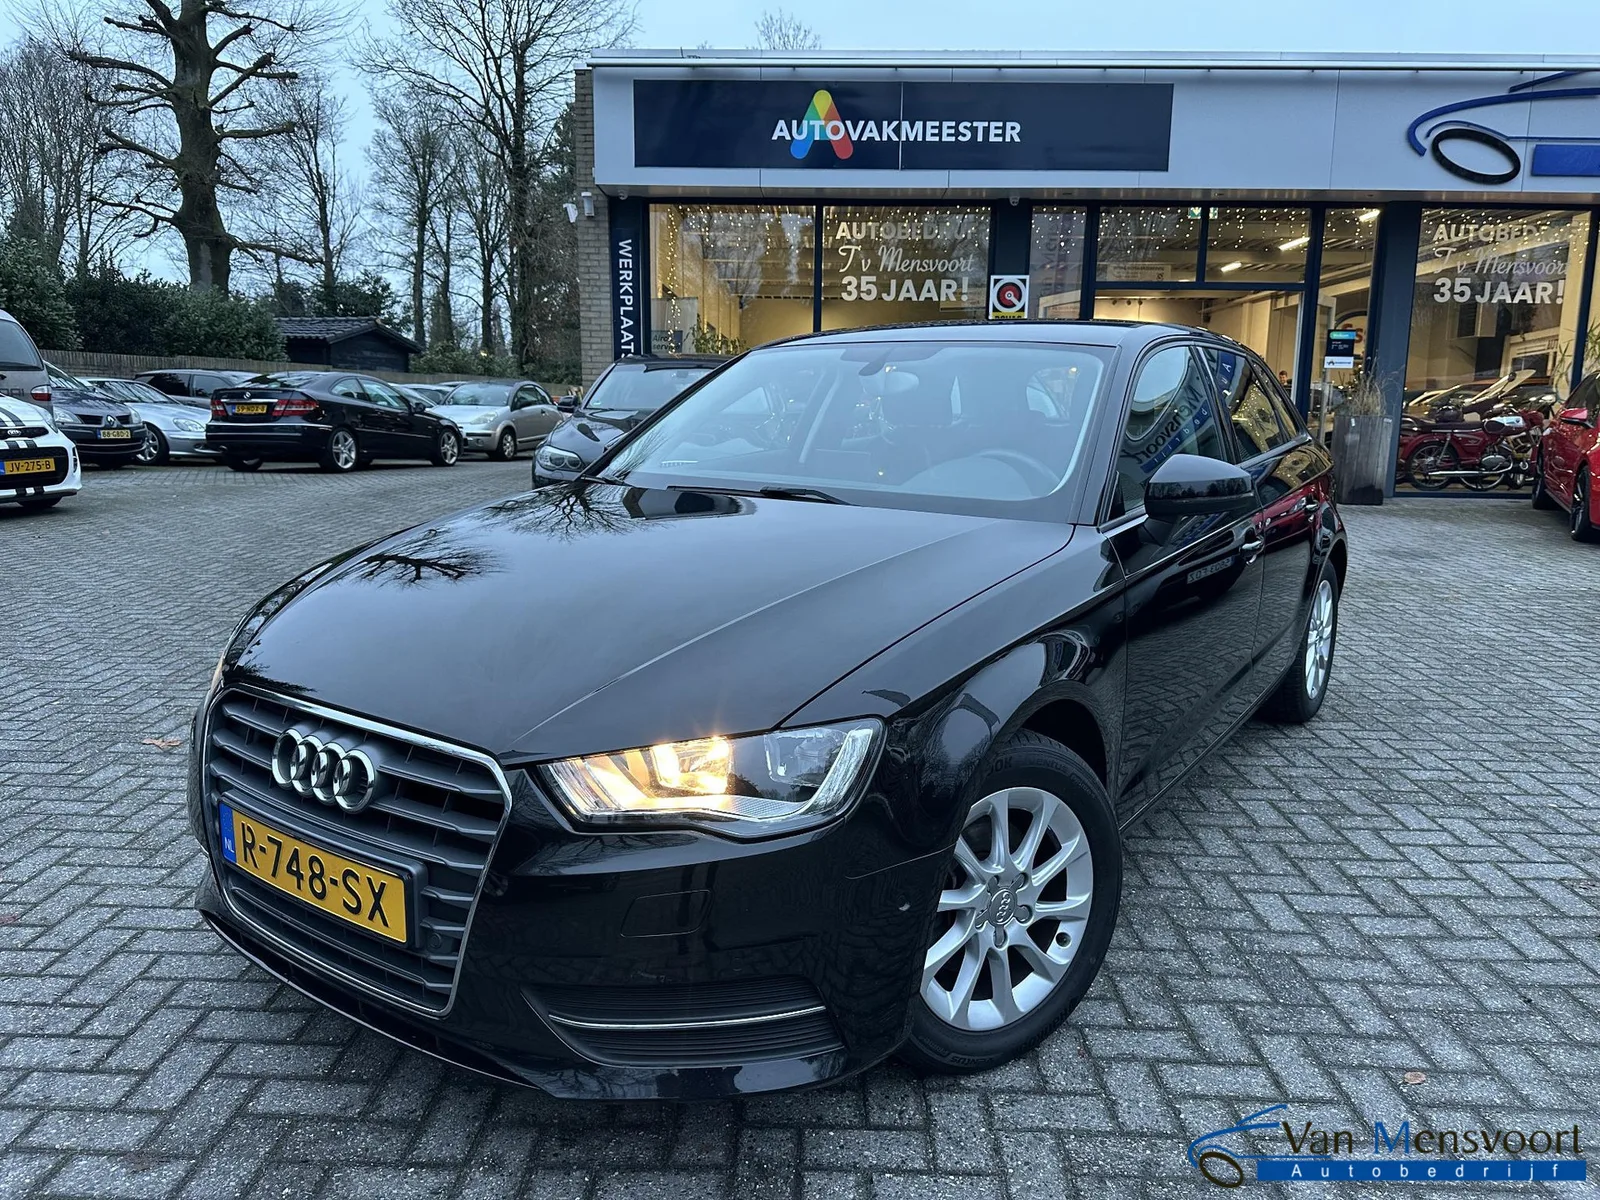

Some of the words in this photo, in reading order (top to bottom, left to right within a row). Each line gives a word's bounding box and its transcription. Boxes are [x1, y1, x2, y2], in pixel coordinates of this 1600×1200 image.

[771, 119, 1021, 142] AUTOVAKMEESTER
[1432, 223, 1560, 242] AUTOBEDR
[838, 245, 862, 272] T
[878, 245, 975, 272] Mensvoort
[841, 276, 878, 301] 35
[881, 276, 969, 302] JAAR!
[1433, 278, 1471, 302] 35
[1475, 279, 1565, 304] JAAR!
[9, 460, 51, 473] JV-275-B
[240, 820, 390, 928] R-748-SX
